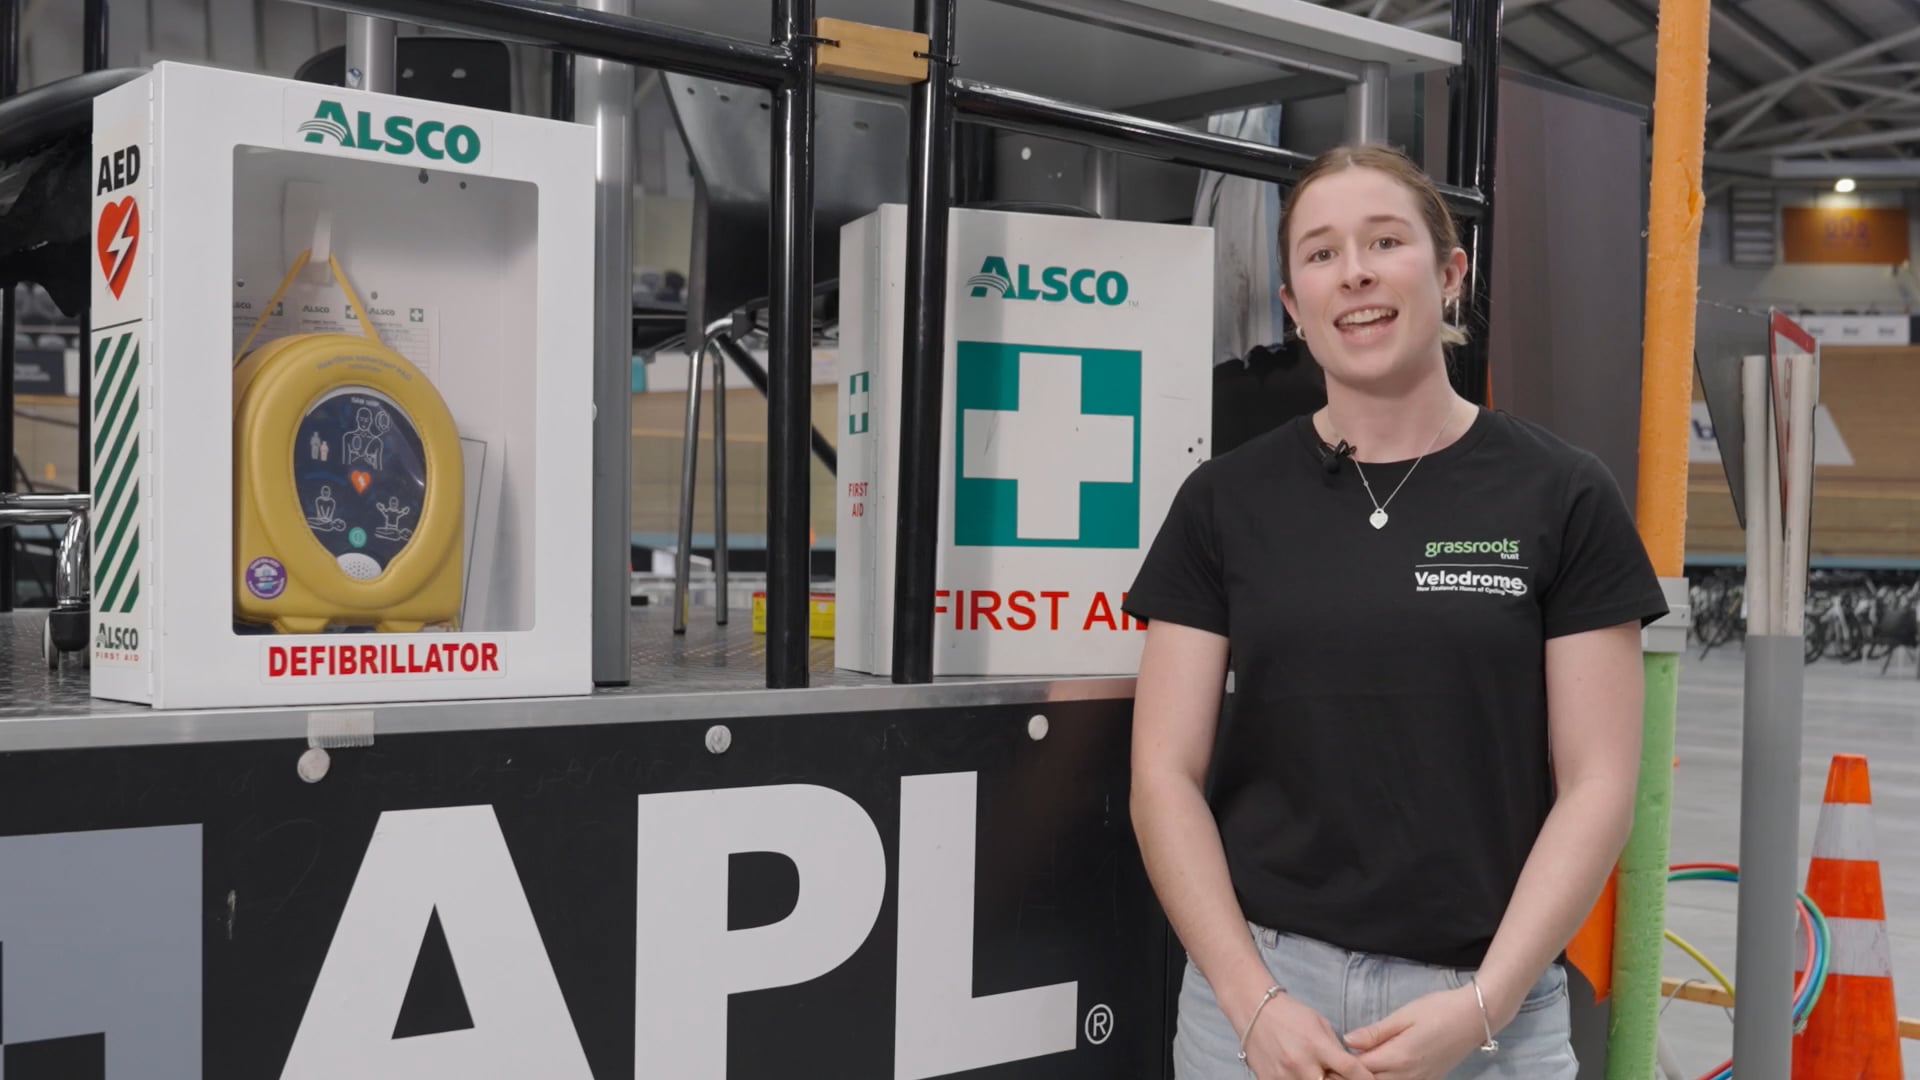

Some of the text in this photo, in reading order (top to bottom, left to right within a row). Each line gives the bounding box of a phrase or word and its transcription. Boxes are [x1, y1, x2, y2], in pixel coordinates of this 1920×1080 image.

[297, 99, 481, 164] ALSCO
[97, 144, 141, 196] AED
[966, 255, 1129, 306] ALSCO
[233, 301, 252, 309] SCO
[848, 481, 869, 497] FIRST
[851, 502, 865, 518] AID
[1425, 538, 1519, 558] grassroots
[1500, 552, 1519, 560] trust
[1414, 570, 1523, 589] Velodrome
[1082, 591, 1149, 631] AI
[96, 622, 139, 651] ALSCO
[95, 651, 139, 662] FIRST AID
[268, 642, 499, 677] DEFIBRILLATOR
[279, 771, 1078, 1080] APL
